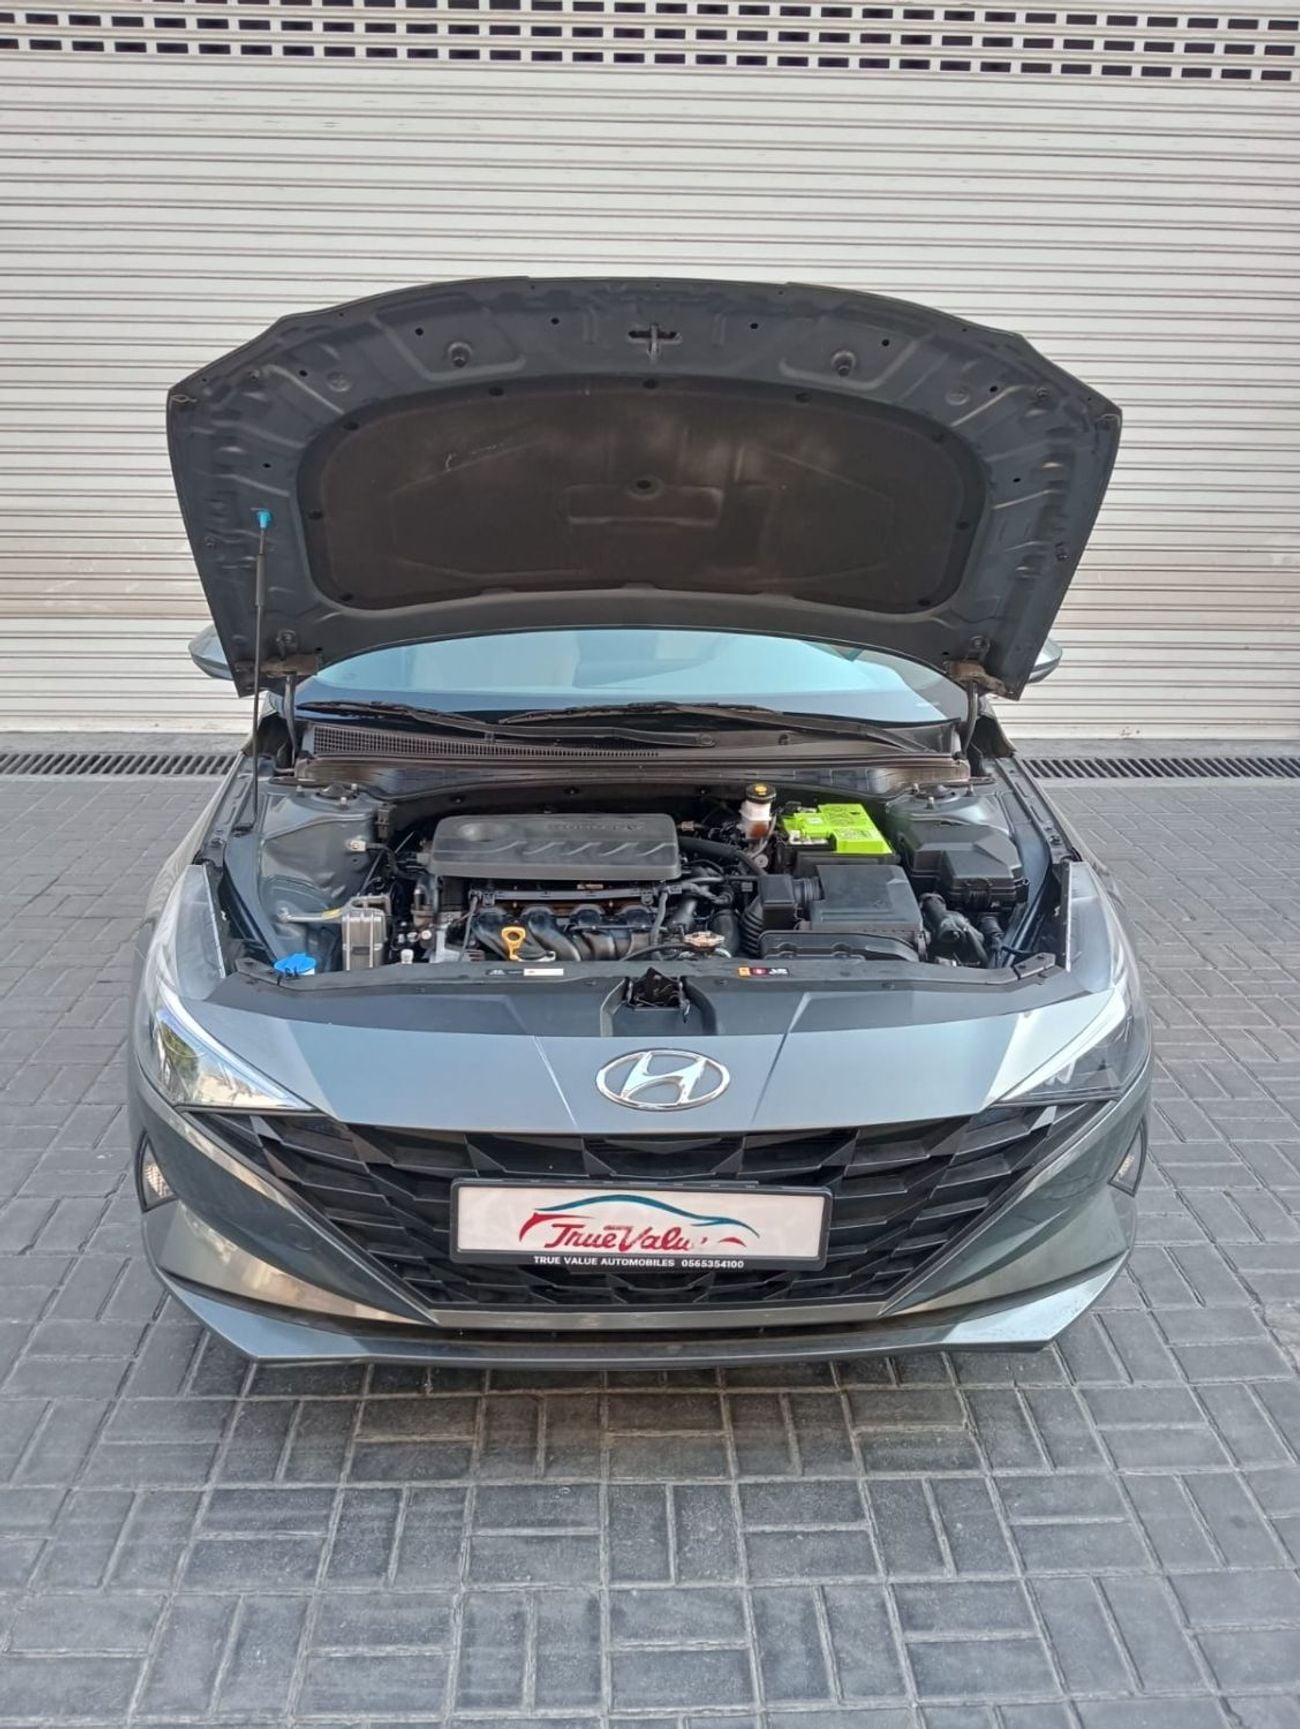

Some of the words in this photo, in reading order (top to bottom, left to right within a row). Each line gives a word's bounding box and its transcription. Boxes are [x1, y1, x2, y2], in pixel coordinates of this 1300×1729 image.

[603, 1225, 709, 1252] Valu
[533, 1256, 561, 1265] TRUE
[563, 1256, 598, 1266] VALUE
[600, 1257, 675, 1268] AUTOMOBILES
